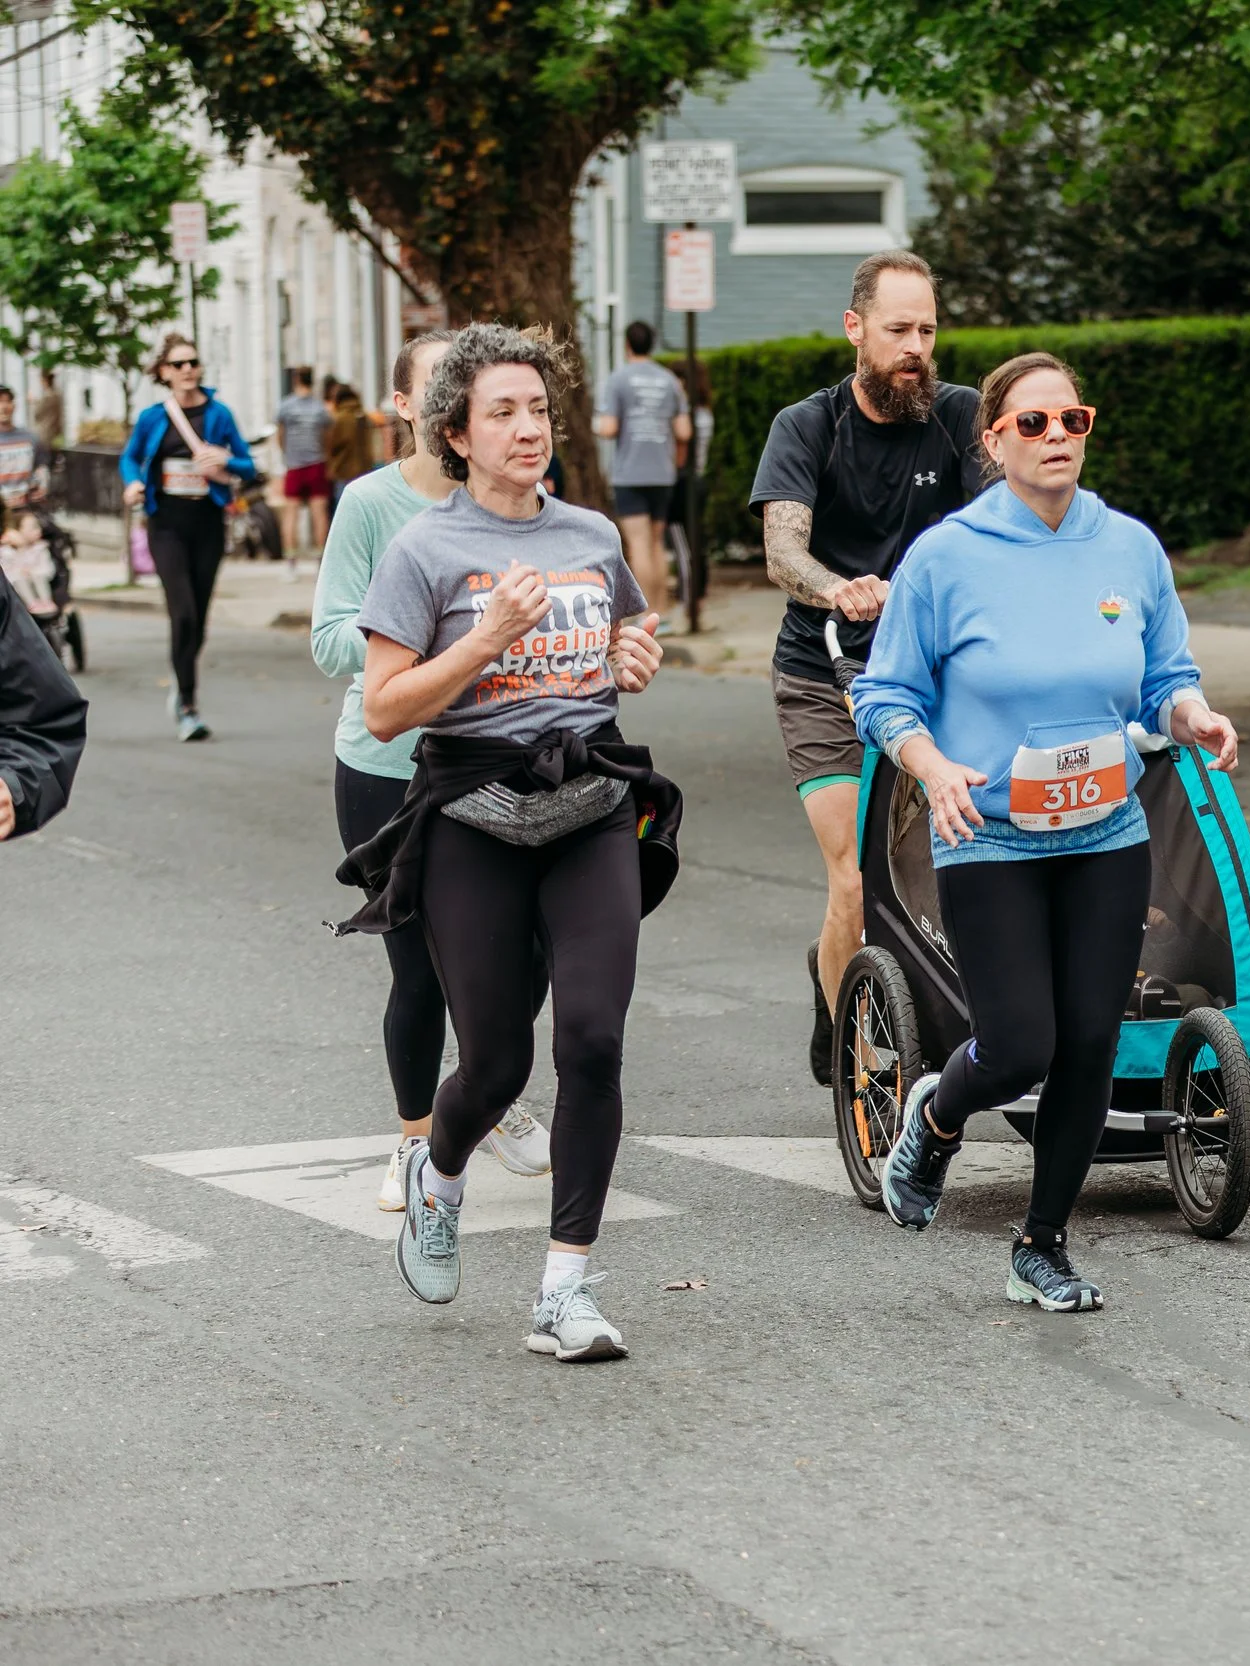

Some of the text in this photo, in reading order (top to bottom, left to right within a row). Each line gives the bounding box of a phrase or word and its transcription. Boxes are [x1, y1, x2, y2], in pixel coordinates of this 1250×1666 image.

[467, 574, 493, 592] 28
[502, 652, 607, 676] RACIS
[1042, 775, 1102, 810] 316
